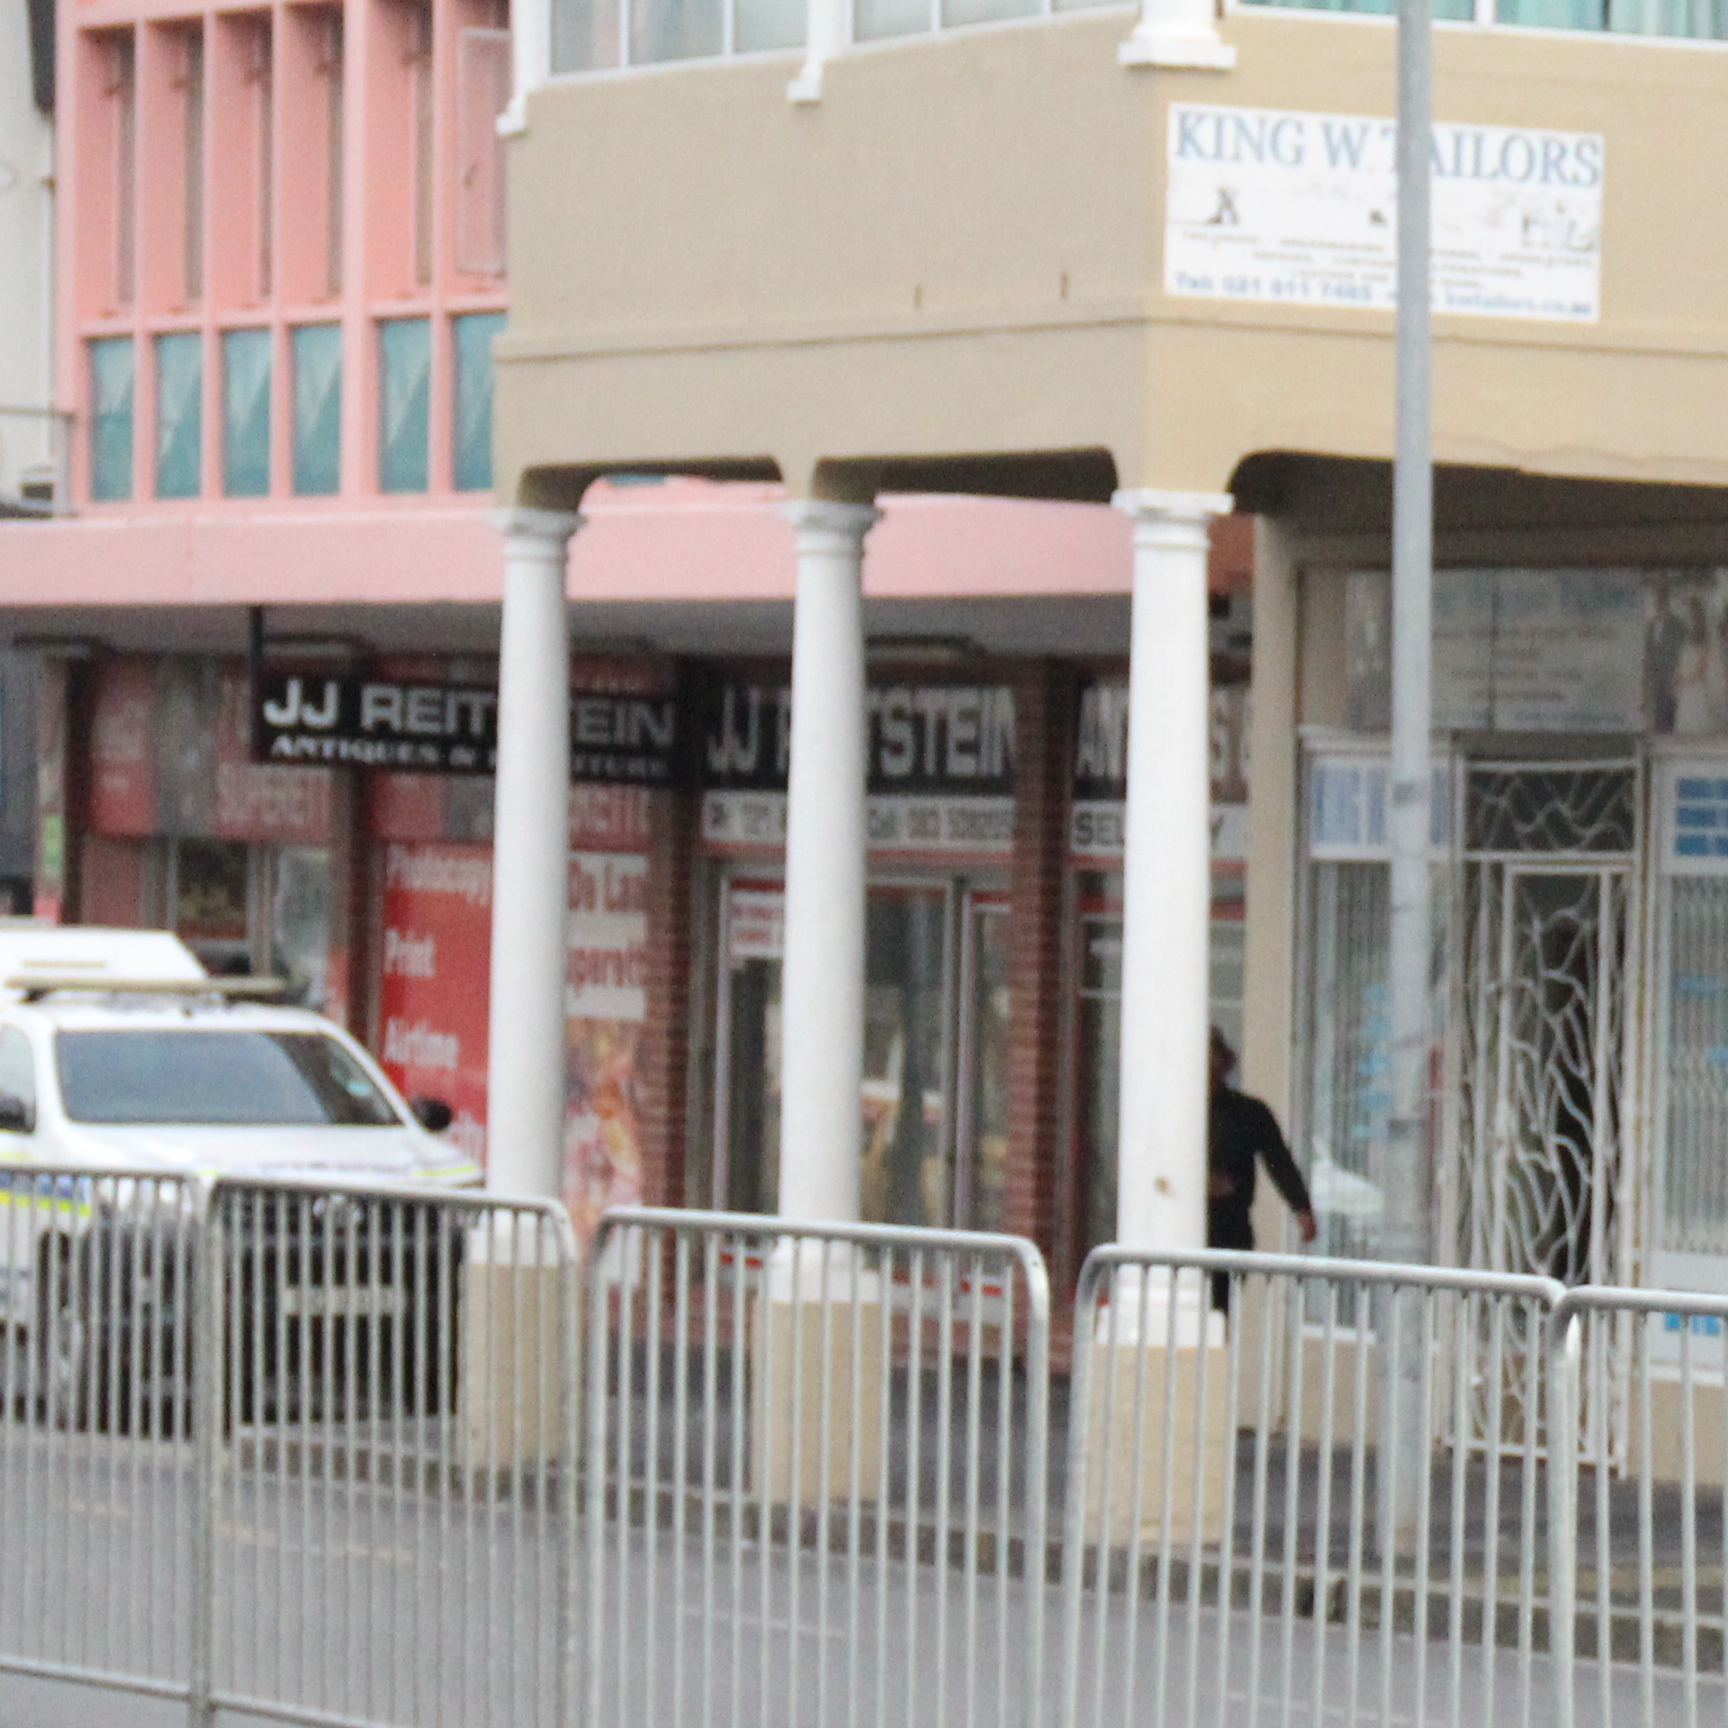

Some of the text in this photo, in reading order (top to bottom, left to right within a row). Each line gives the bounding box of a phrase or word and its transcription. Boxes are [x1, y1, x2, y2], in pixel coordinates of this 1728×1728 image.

[1176, 110, 1305, 167] KING
[262, 678, 676, 750] JJ REITEIN
[776, 685, 1019, 777] STEIN
